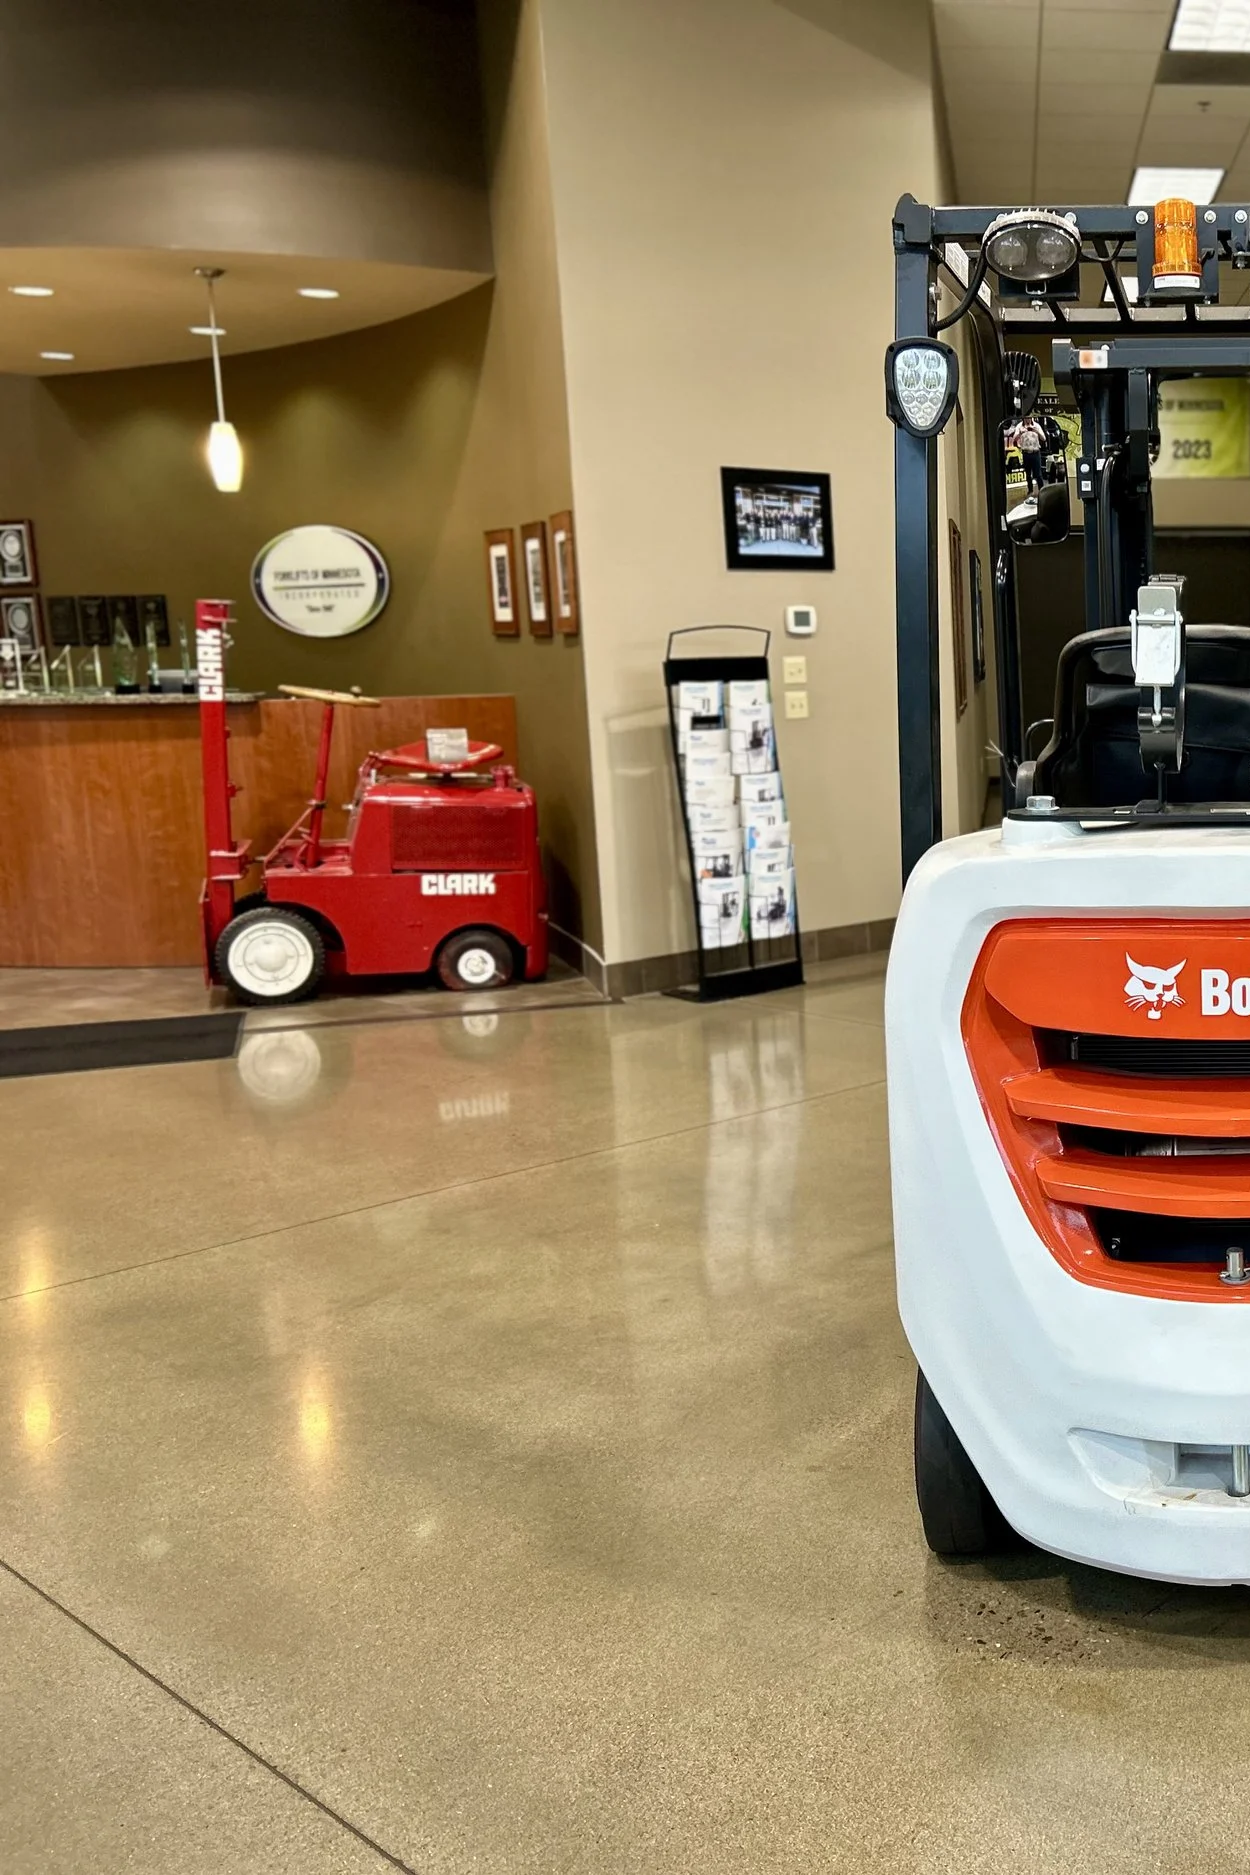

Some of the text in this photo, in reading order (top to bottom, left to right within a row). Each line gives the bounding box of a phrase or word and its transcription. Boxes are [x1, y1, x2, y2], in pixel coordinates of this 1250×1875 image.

[1173, 440, 1211, 459] 2023
[196, 628, 223, 701] CLARK
[421, 873, 497, 896] CLARK
